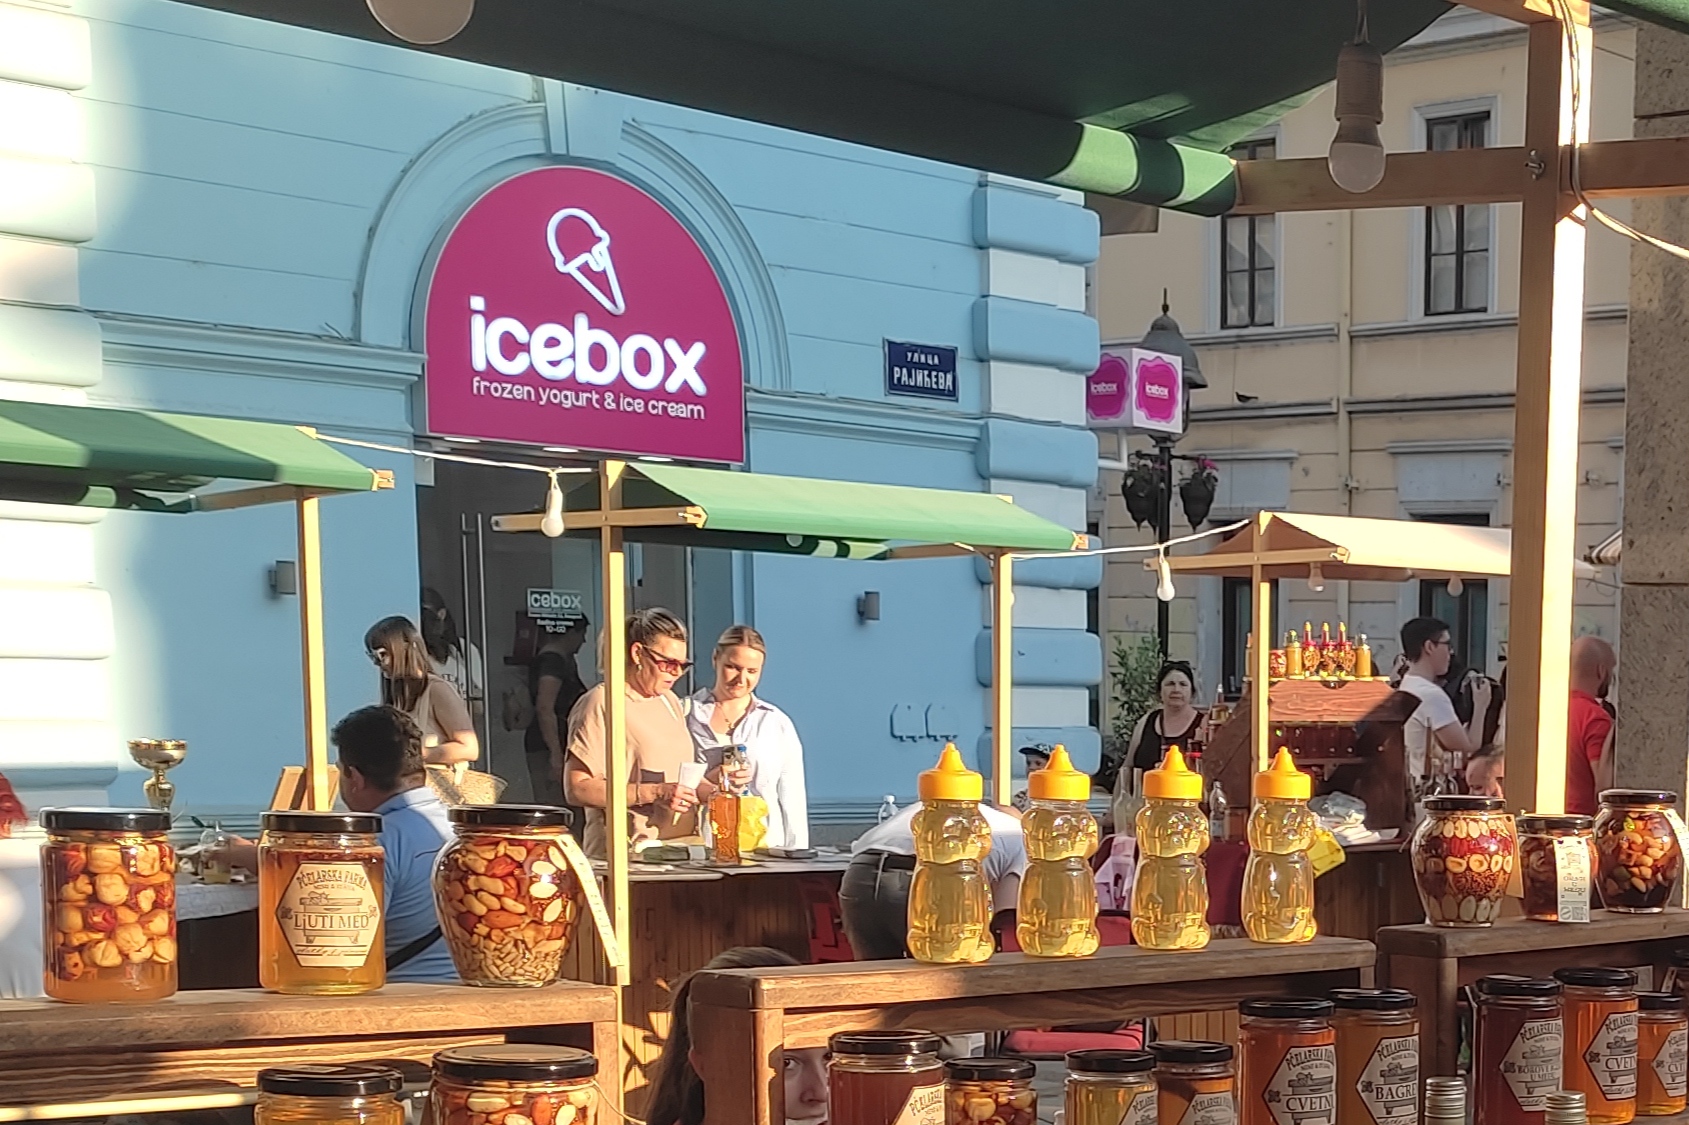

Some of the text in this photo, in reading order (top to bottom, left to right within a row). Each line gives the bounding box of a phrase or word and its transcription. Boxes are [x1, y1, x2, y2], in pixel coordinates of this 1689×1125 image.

[470, 295, 707, 397] icebox
[472, 376, 705, 420] frozen yogurt & ice cream
[339, 915, 369, 929] MED
